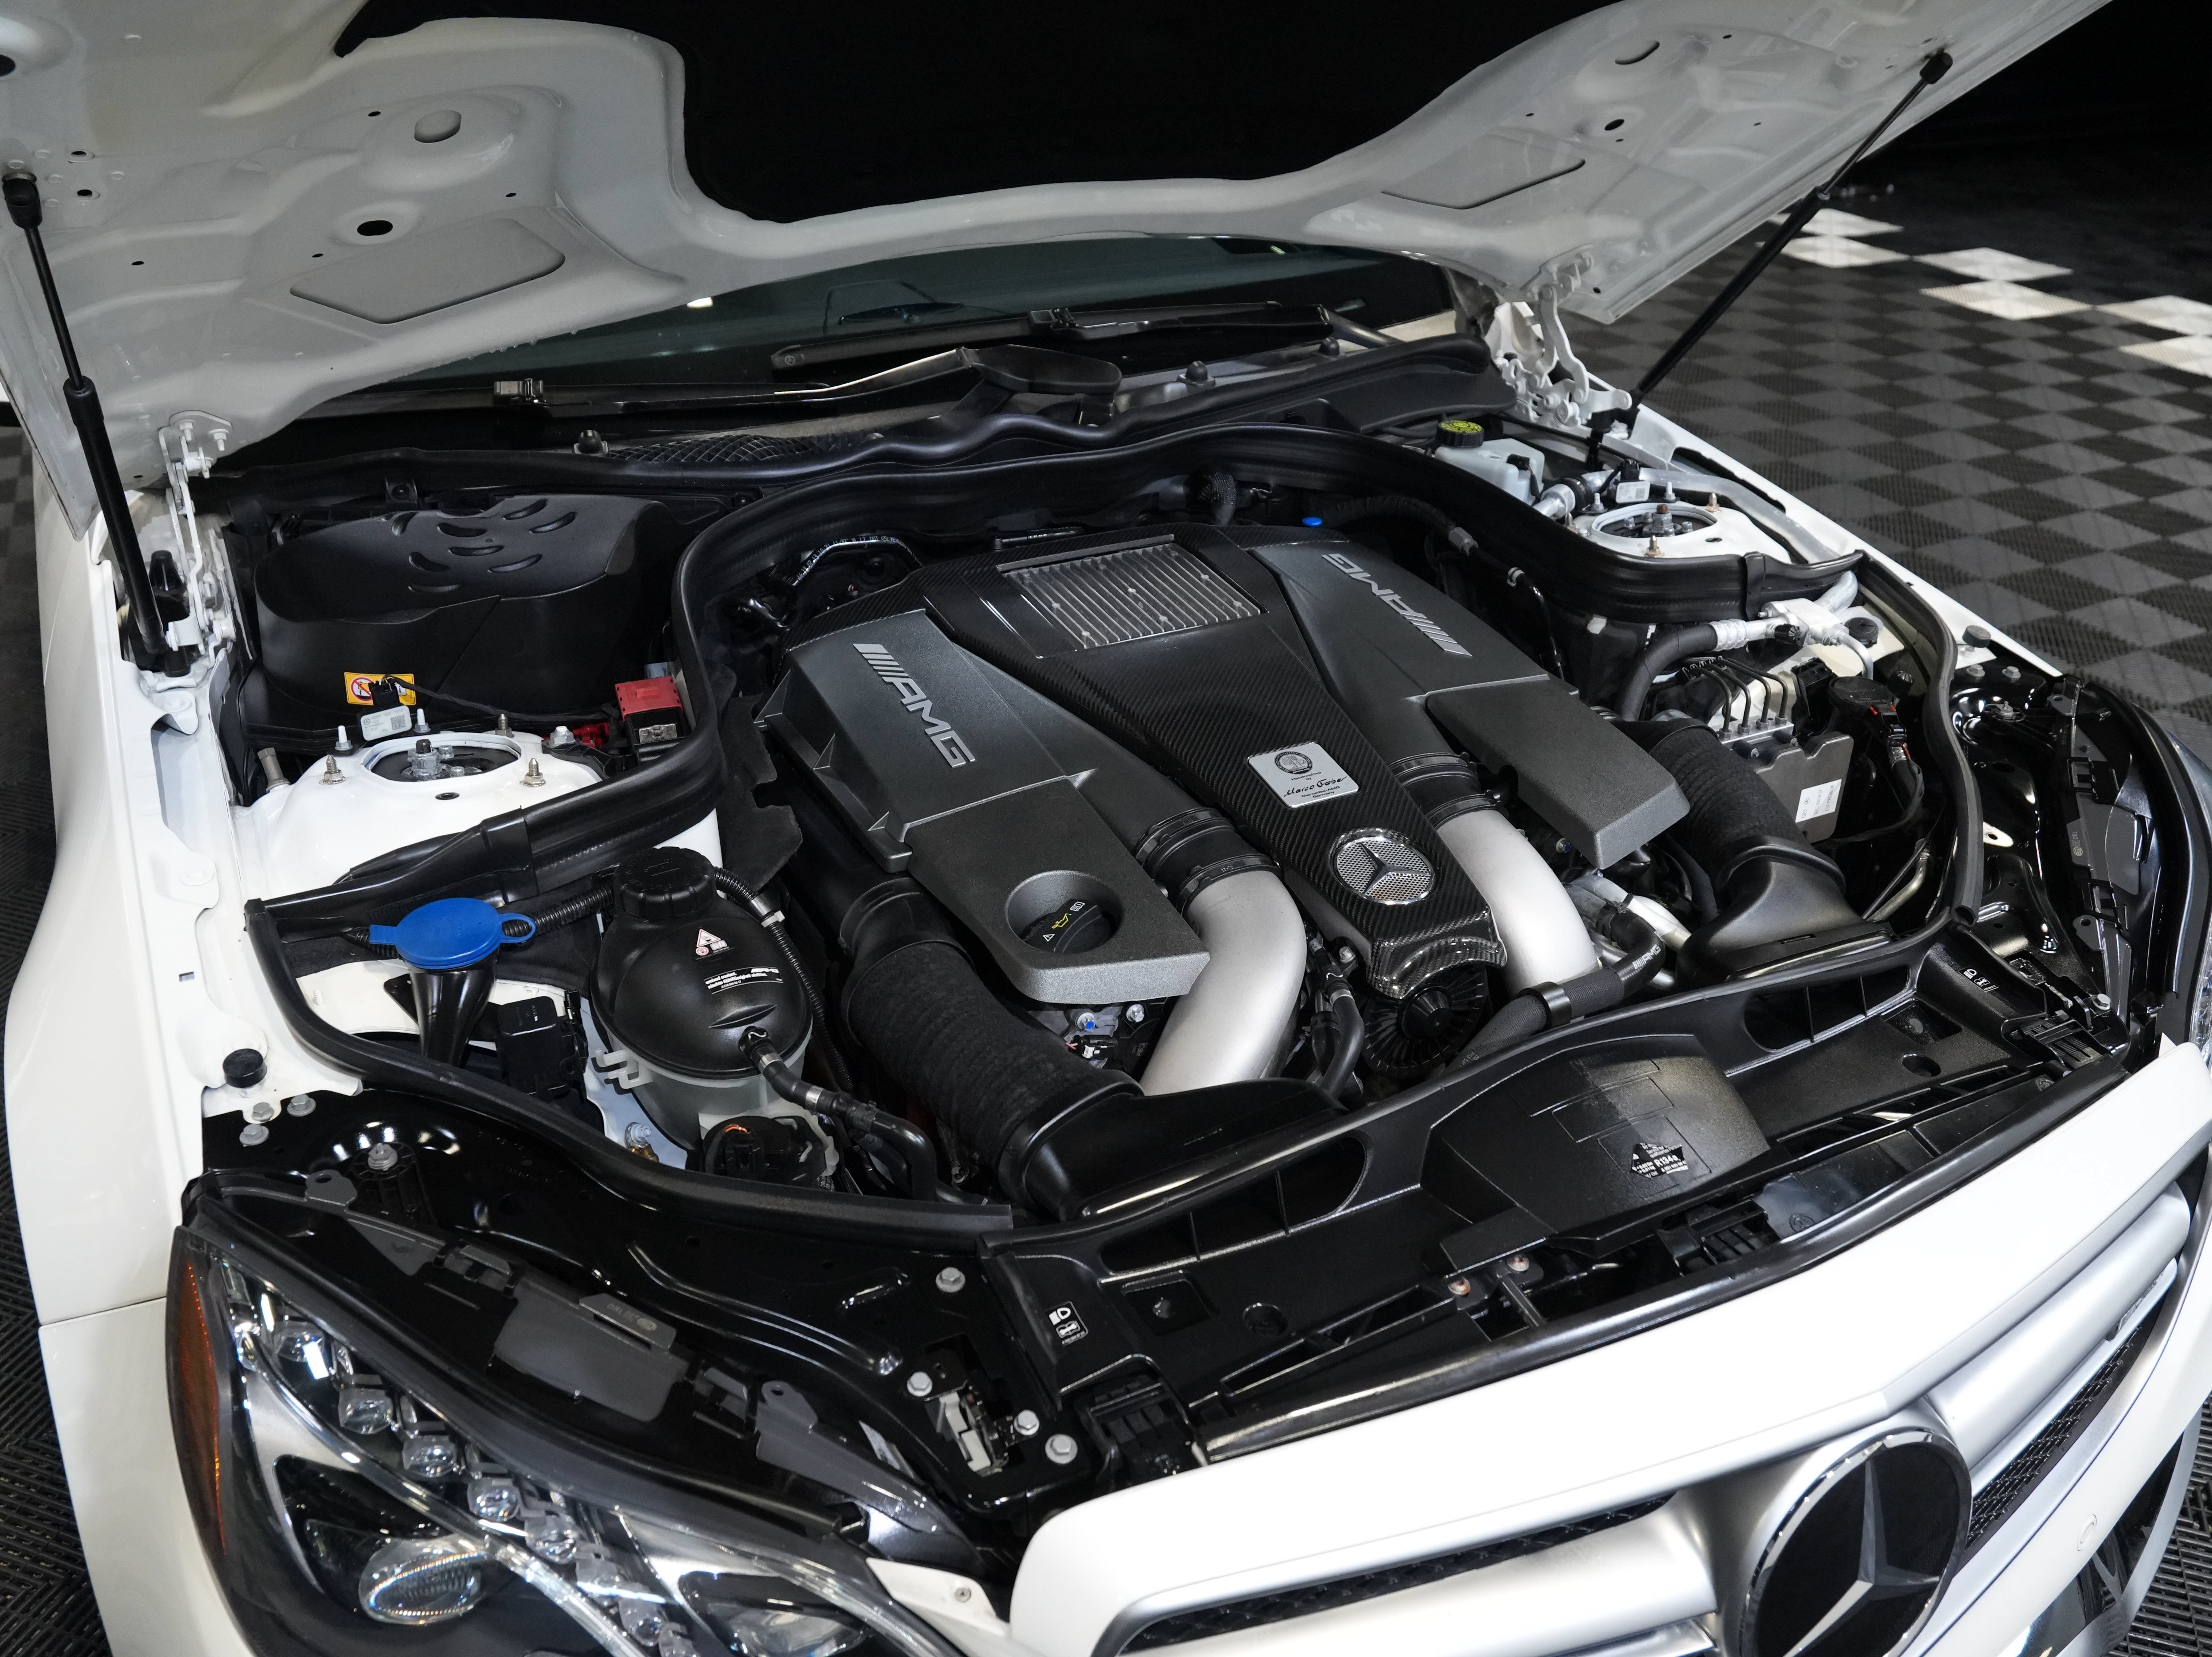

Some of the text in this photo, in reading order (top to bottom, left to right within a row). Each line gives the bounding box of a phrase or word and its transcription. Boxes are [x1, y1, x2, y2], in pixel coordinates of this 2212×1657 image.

[1321, 554, 1428, 619] AMG
[882, 676, 976, 768] AMG
[1291, 771, 1322, 781] Handcrafted
[1301, 786, 1340, 797] Mercedes-AMG
[1641, 944, 1661, 964] AMG
